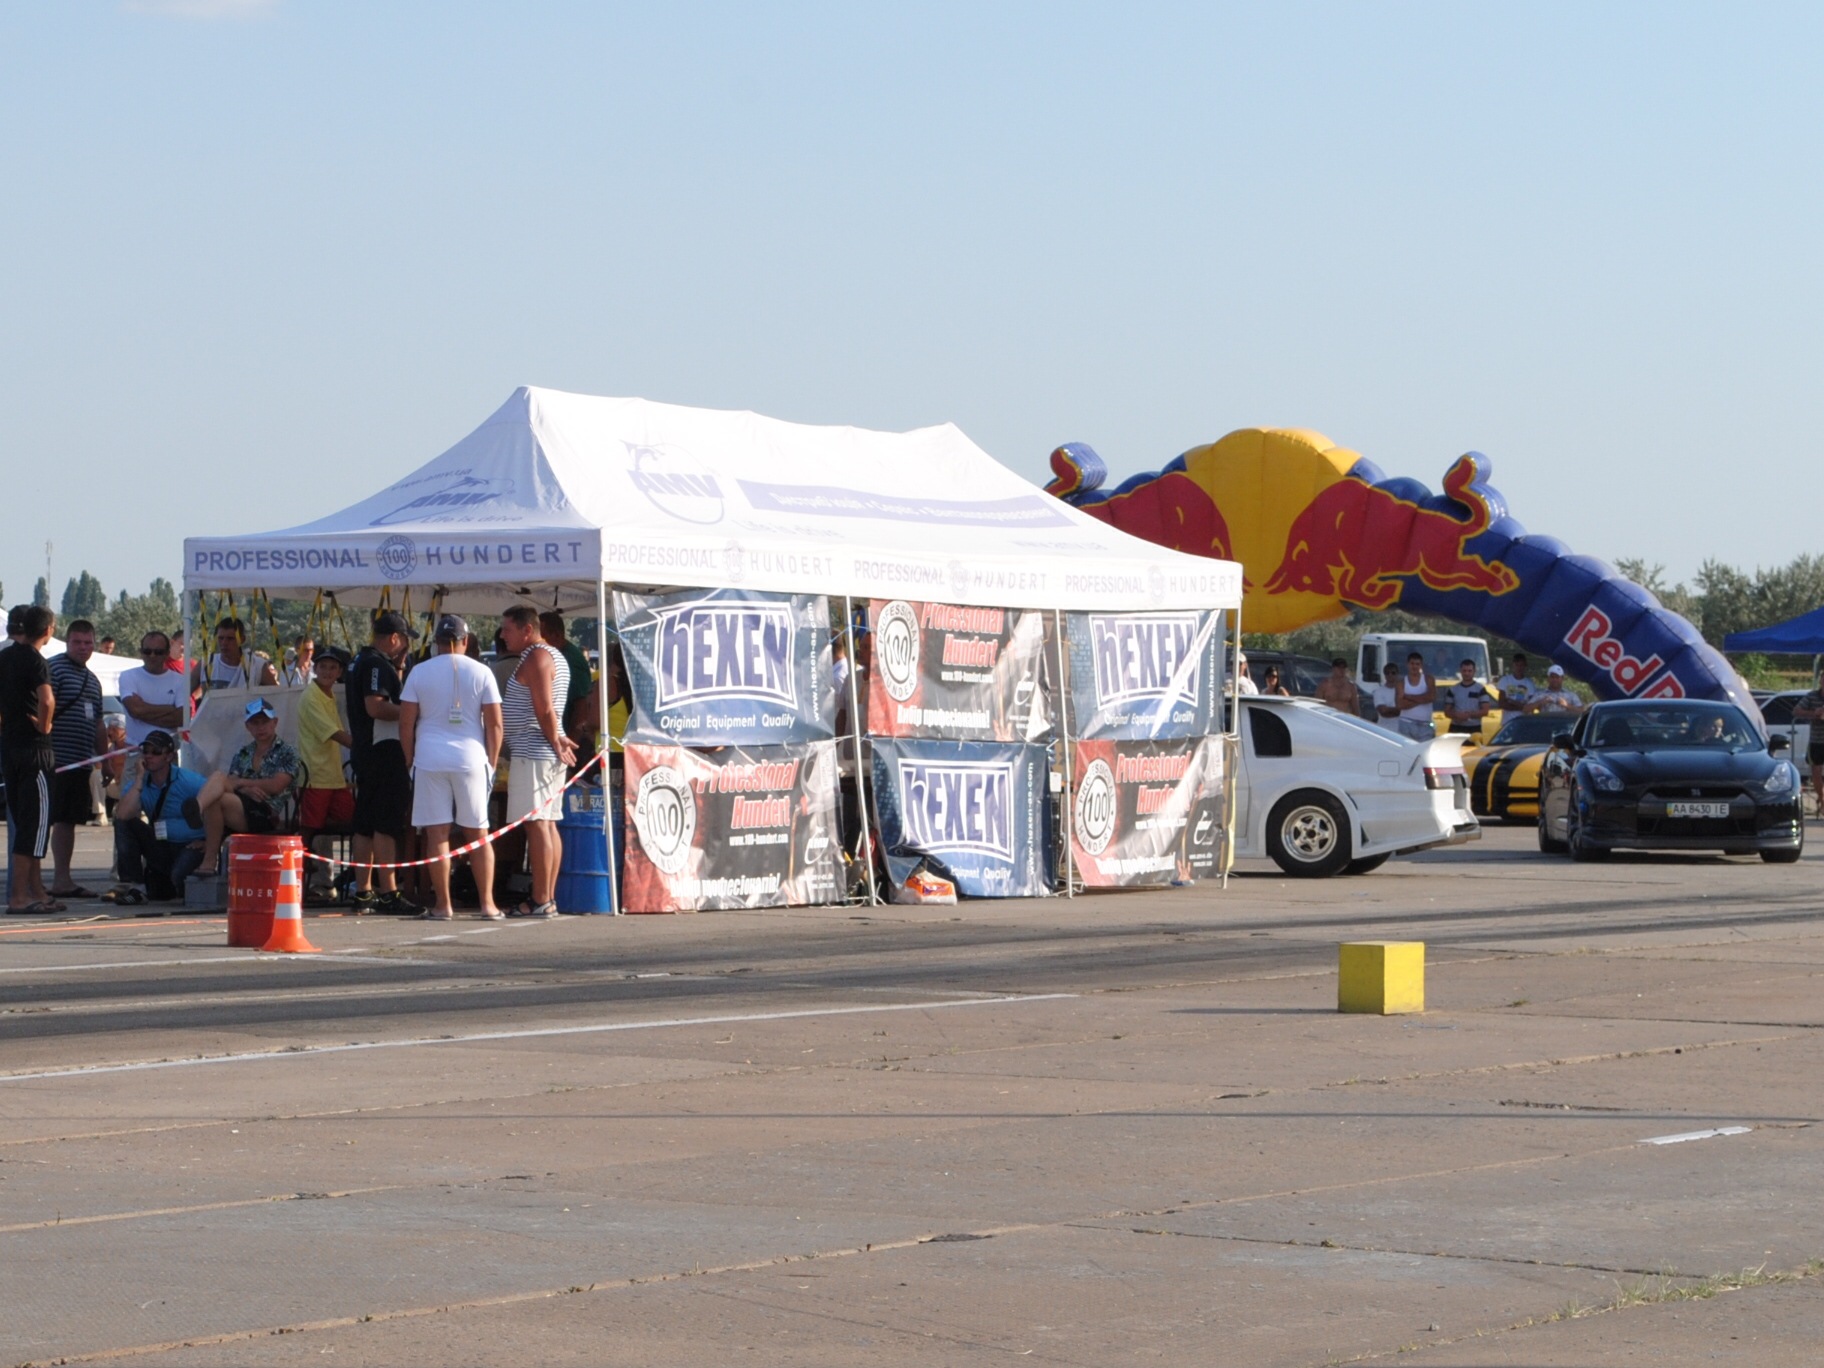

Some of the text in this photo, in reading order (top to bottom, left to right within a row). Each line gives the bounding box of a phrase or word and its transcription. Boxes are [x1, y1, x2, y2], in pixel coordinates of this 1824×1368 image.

[195, 542, 582, 571] PROFESSIONAL 100 HUNDERT
[608, 543, 718, 569] PROFESSIONAL
[750, 552, 833, 577] HUNDERT
[854, 559, 946, 585] PROFESSIONAL
[973, 572, 1048, 590] HUNDERT
[1065, 574, 1145, 594] PROFESSIONAL
[1169, 574, 1236, 593] HUNDERT
[877, 604, 919, 648] PROFESSIONAL
[921, 602, 1005, 634] Professional
[886, 634, 909, 667] 100
[942, 633, 999, 668] Hundert
[1563, 603, 1665, 696] Red
[660, 713, 796, 732] Original Equipment Quality
[1173, 709, 1195, 725] Quality
[1115, 751, 1192, 784] Professional
[649, 802, 680, 837] 100
[730, 795, 791, 829] Hundert
[1086, 792, 1109, 823] 100
[1673, 804, 1687, 814] AA
[1689, 804, 1711, 814] 8430
[1077, 823, 1114, 854] HUNDERT
[983, 867, 1011, 881] Quality
